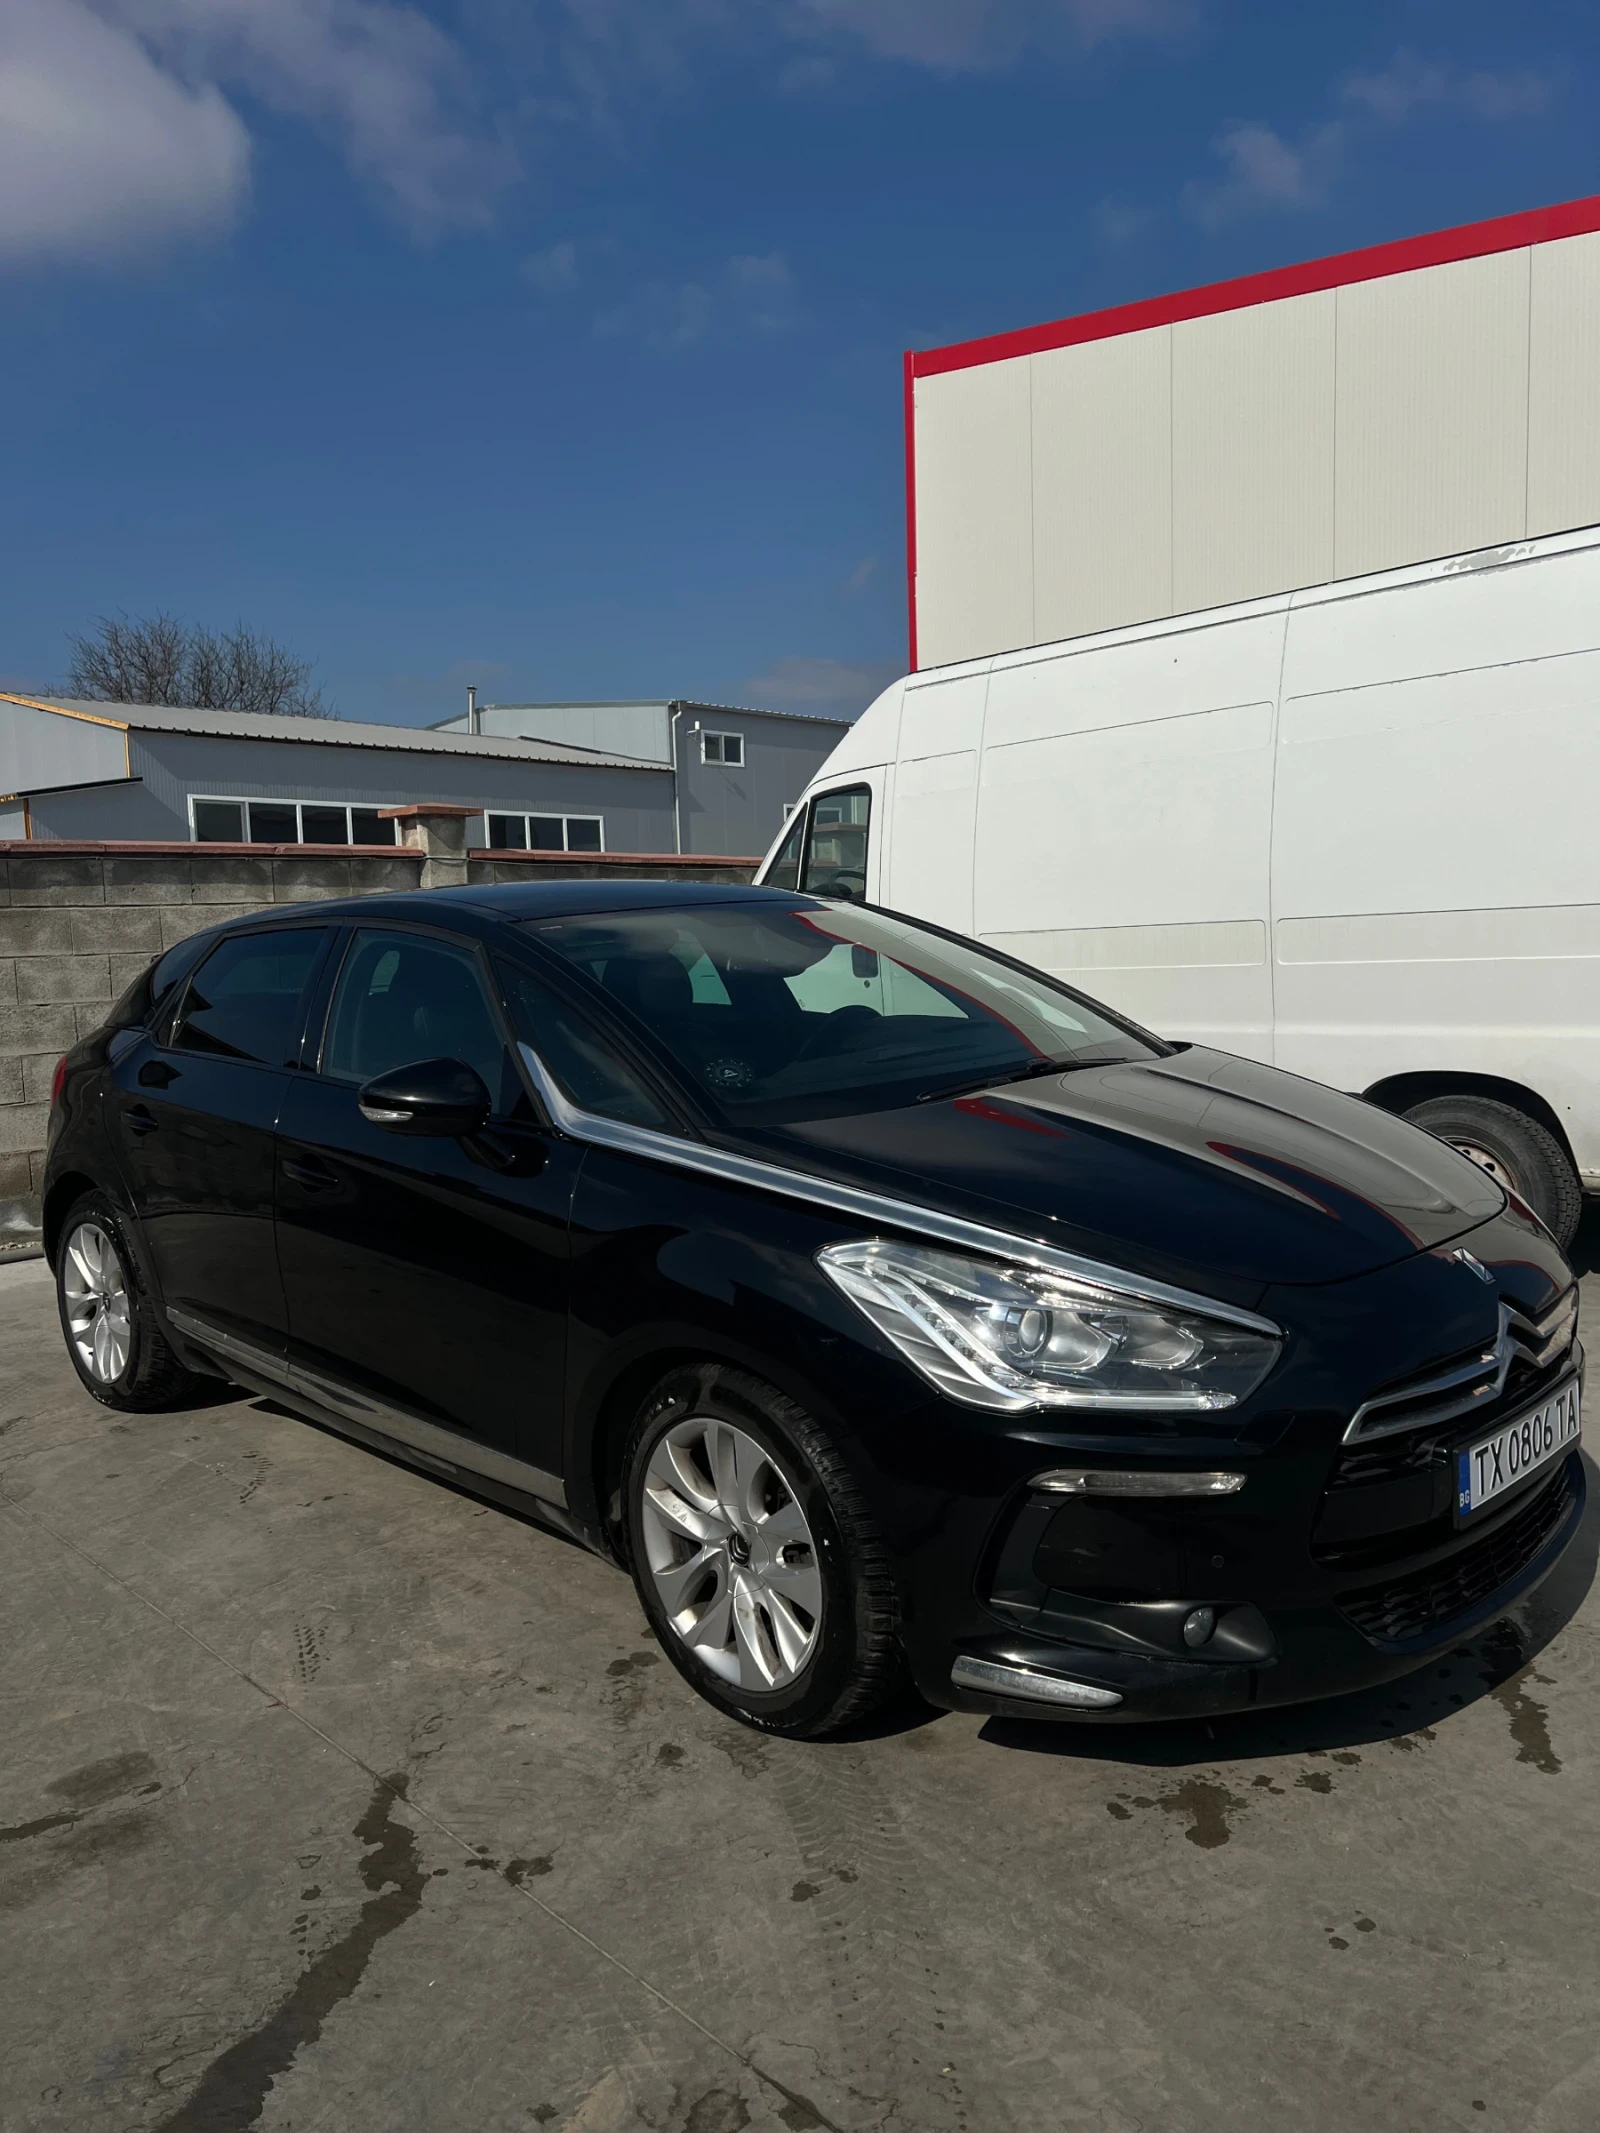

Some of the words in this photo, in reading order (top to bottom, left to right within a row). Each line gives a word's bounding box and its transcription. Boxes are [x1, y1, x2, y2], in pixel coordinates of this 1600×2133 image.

[1474, 1437, 1504, 1496] TX
[1508, 1407, 1553, 1475] 0806
[1555, 1389, 1577, 1441] TA
[1459, 1490, 1471, 1507] BG
